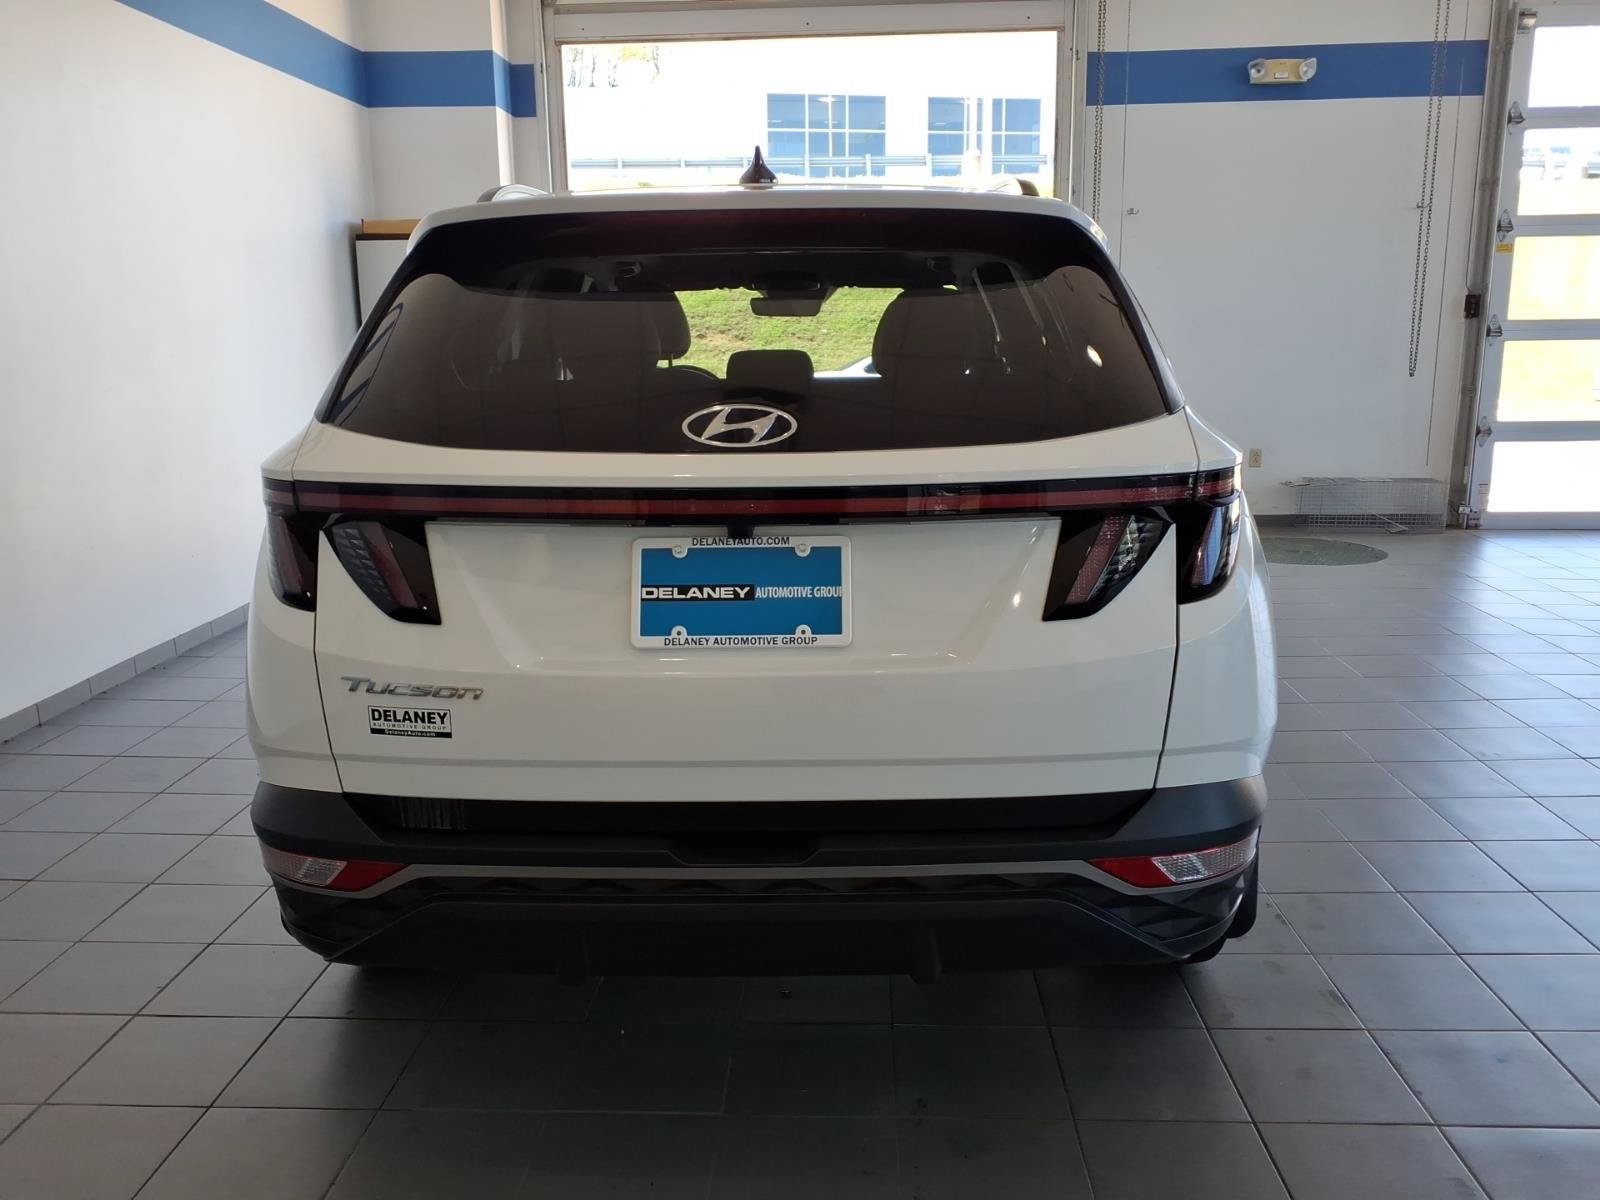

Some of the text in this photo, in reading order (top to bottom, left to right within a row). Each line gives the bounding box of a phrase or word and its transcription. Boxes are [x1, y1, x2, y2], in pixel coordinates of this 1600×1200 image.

[692, 537, 790, 546] DELANEYAUTO.COM
[641, 586, 751, 599] DELANEY
[754, 586, 813, 599] AUTOMOTIVE
[664, 636, 818, 646] DELANEY AUTOMOTIVE GROUP
[370, 708, 448, 725] DELANEY
